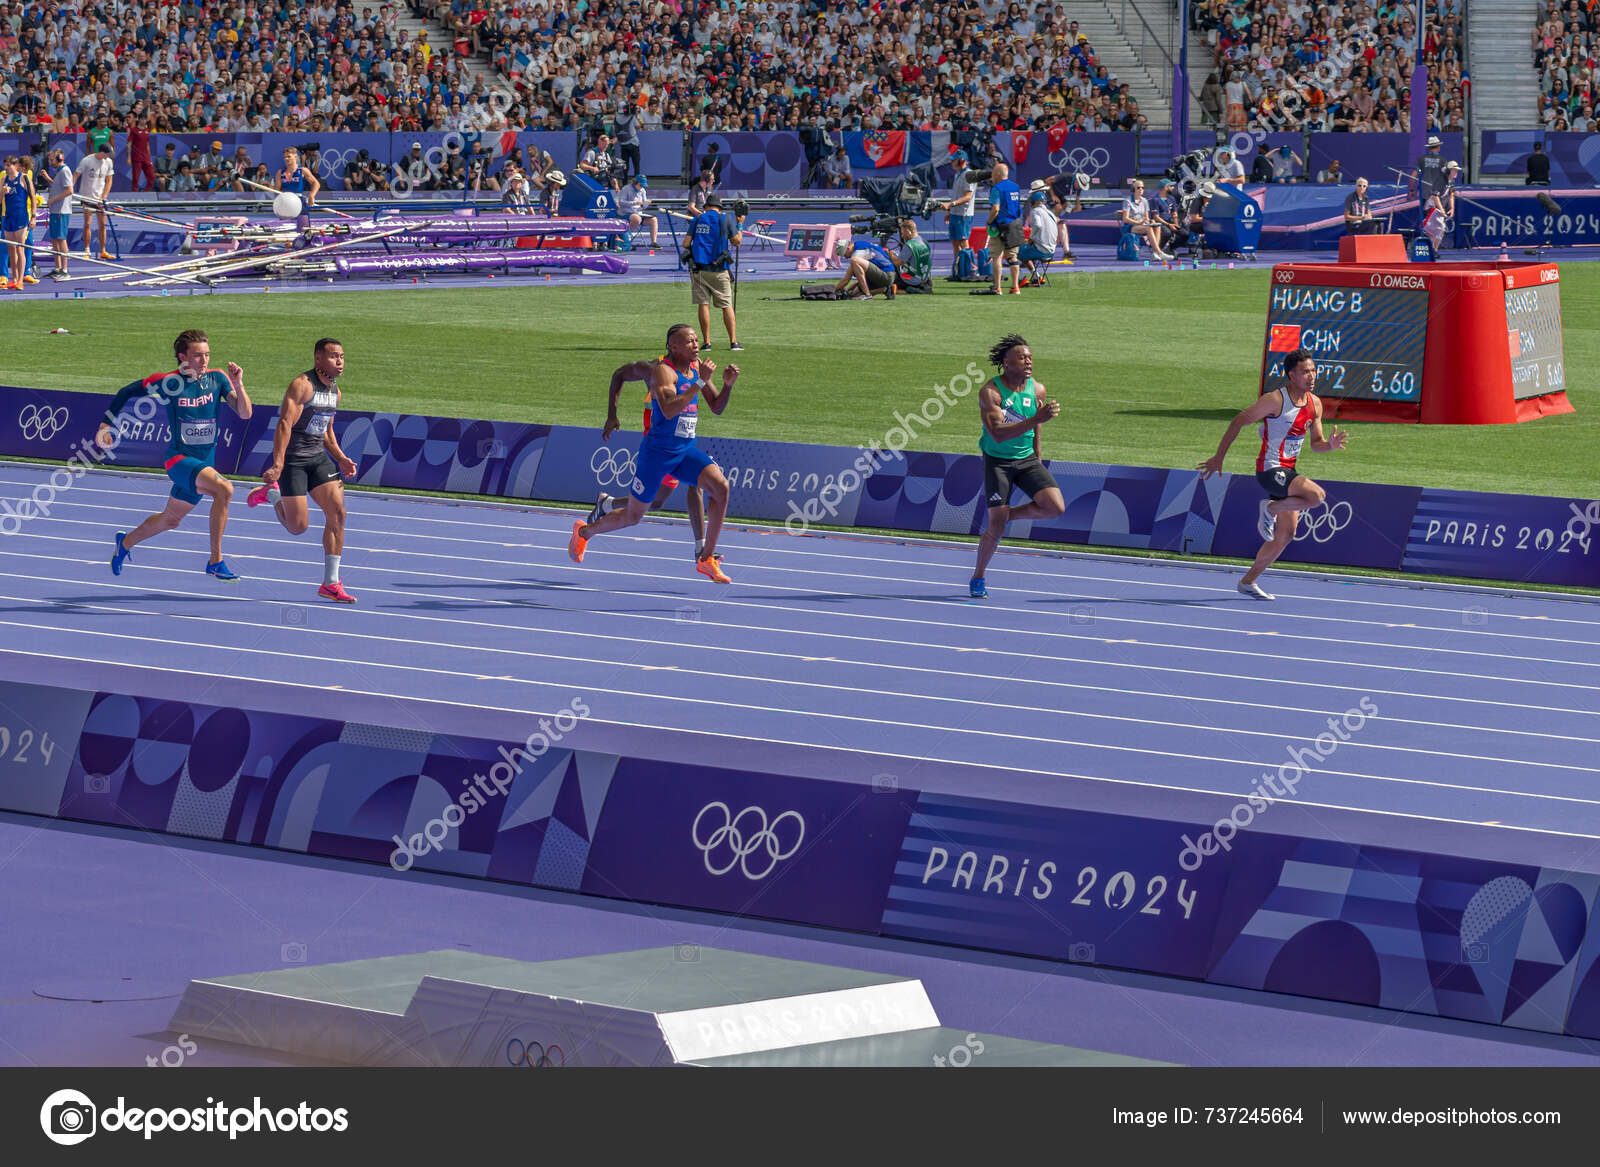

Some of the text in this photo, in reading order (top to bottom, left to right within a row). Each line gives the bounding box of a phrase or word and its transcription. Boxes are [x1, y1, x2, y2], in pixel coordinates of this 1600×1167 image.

[1471, 216, 1535, 236] PARIS
[1384, 275, 1425, 288] OMEGA
[1273, 289, 1362, 313] HUANG B
[1301, 329, 1341, 351] CHN
[1332, 365, 1346, 389] 2
[1371, 370, 1414, 394] 5.60
[178, 393, 214, 408] GUAM
[118, 421, 172, 442] PARIS
[185, 427, 213, 437] GREEN
[1425, 520, 1591, 555] PARIS 2024
[922, 847, 1197, 919] PARIS 2024
[698, 1013, 801, 1046] PARIS
